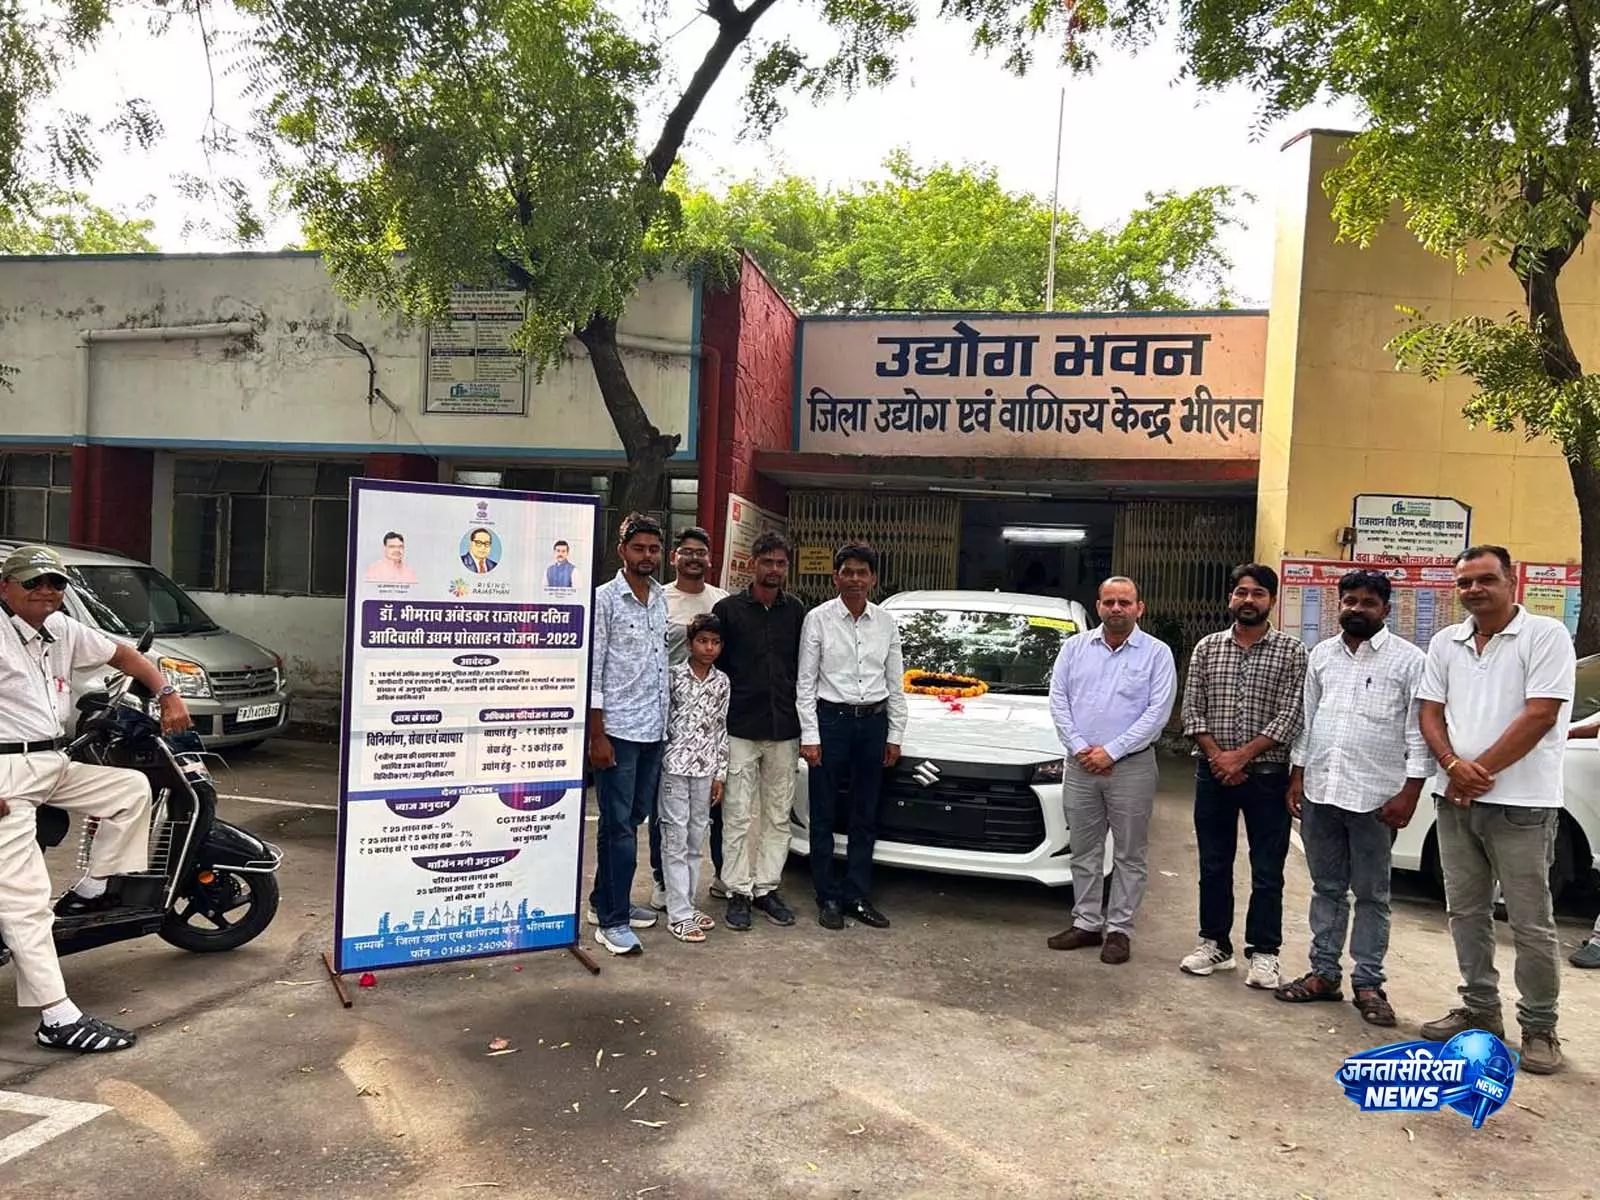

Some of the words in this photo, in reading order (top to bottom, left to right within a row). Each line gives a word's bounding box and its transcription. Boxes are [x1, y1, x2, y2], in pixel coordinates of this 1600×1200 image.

[875, 320, 1040, 378] उद्योग
[1054, 333, 1211, 376] भवन
[807, 386, 867, 438] जिला
[874, 388, 951, 433] उद्योग
[956, 388, 996, 434] एवं
[998, 384, 1110, 434] वाणिज्य
[1110, 386, 1176, 444] केन्द्र
[1180, 384, 1263, 441] भीलवा
[379, 604, 397, 621] डॉ.
[400, 605, 443, 622] भीमराव
[444, 605, 490, 623] अंबेडकर
[492, 610, 539, 624] राजस्थान
[541, 607, 570, 624] दलित
[368, 627, 425, 644] आदिवासी
[454, 628, 501, 645] प्रोत्साहन
[496, 814, 537, 825] CGTMSE
[395, 935, 420, 947] जिला
